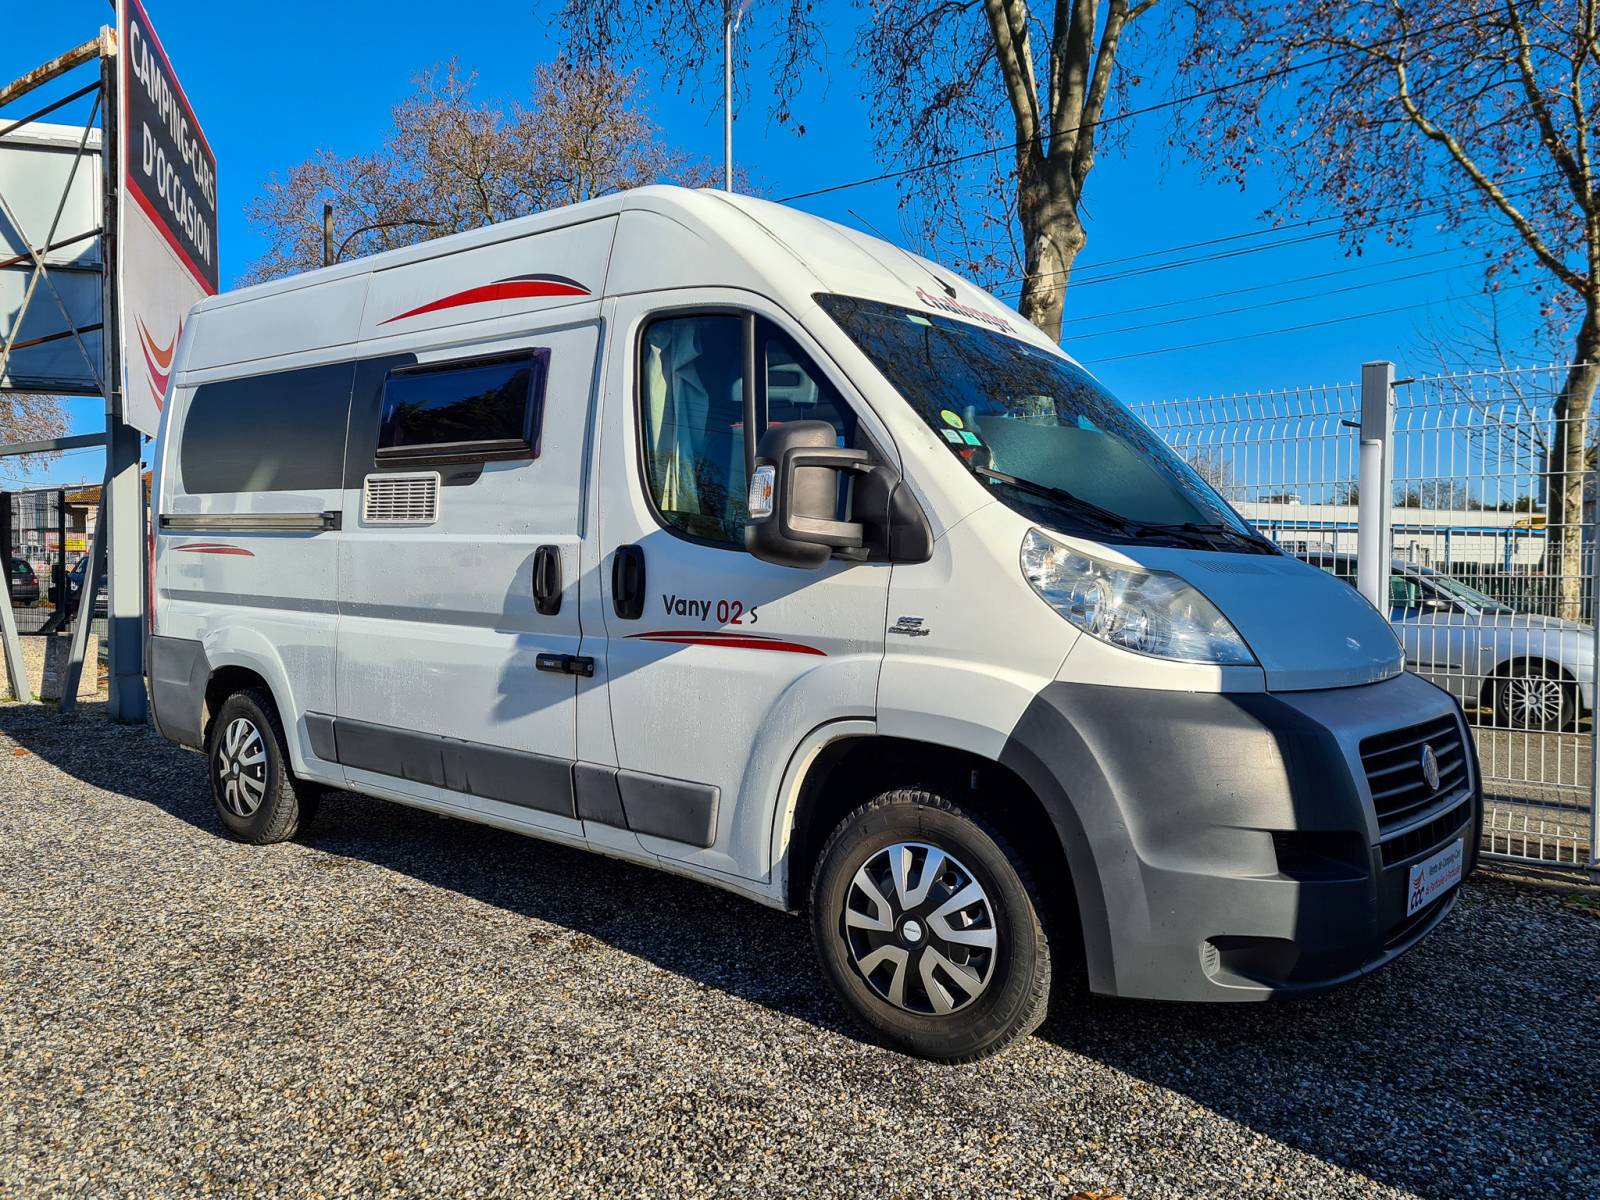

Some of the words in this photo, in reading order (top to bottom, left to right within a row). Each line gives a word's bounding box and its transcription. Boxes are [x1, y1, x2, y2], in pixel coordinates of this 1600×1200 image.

[130, 19, 215, 212] CAMPING-CARS
[142, 121, 211, 266] D'OCCASION
[663, 594, 711, 621] Vany
[717, 600, 743, 625] 02
